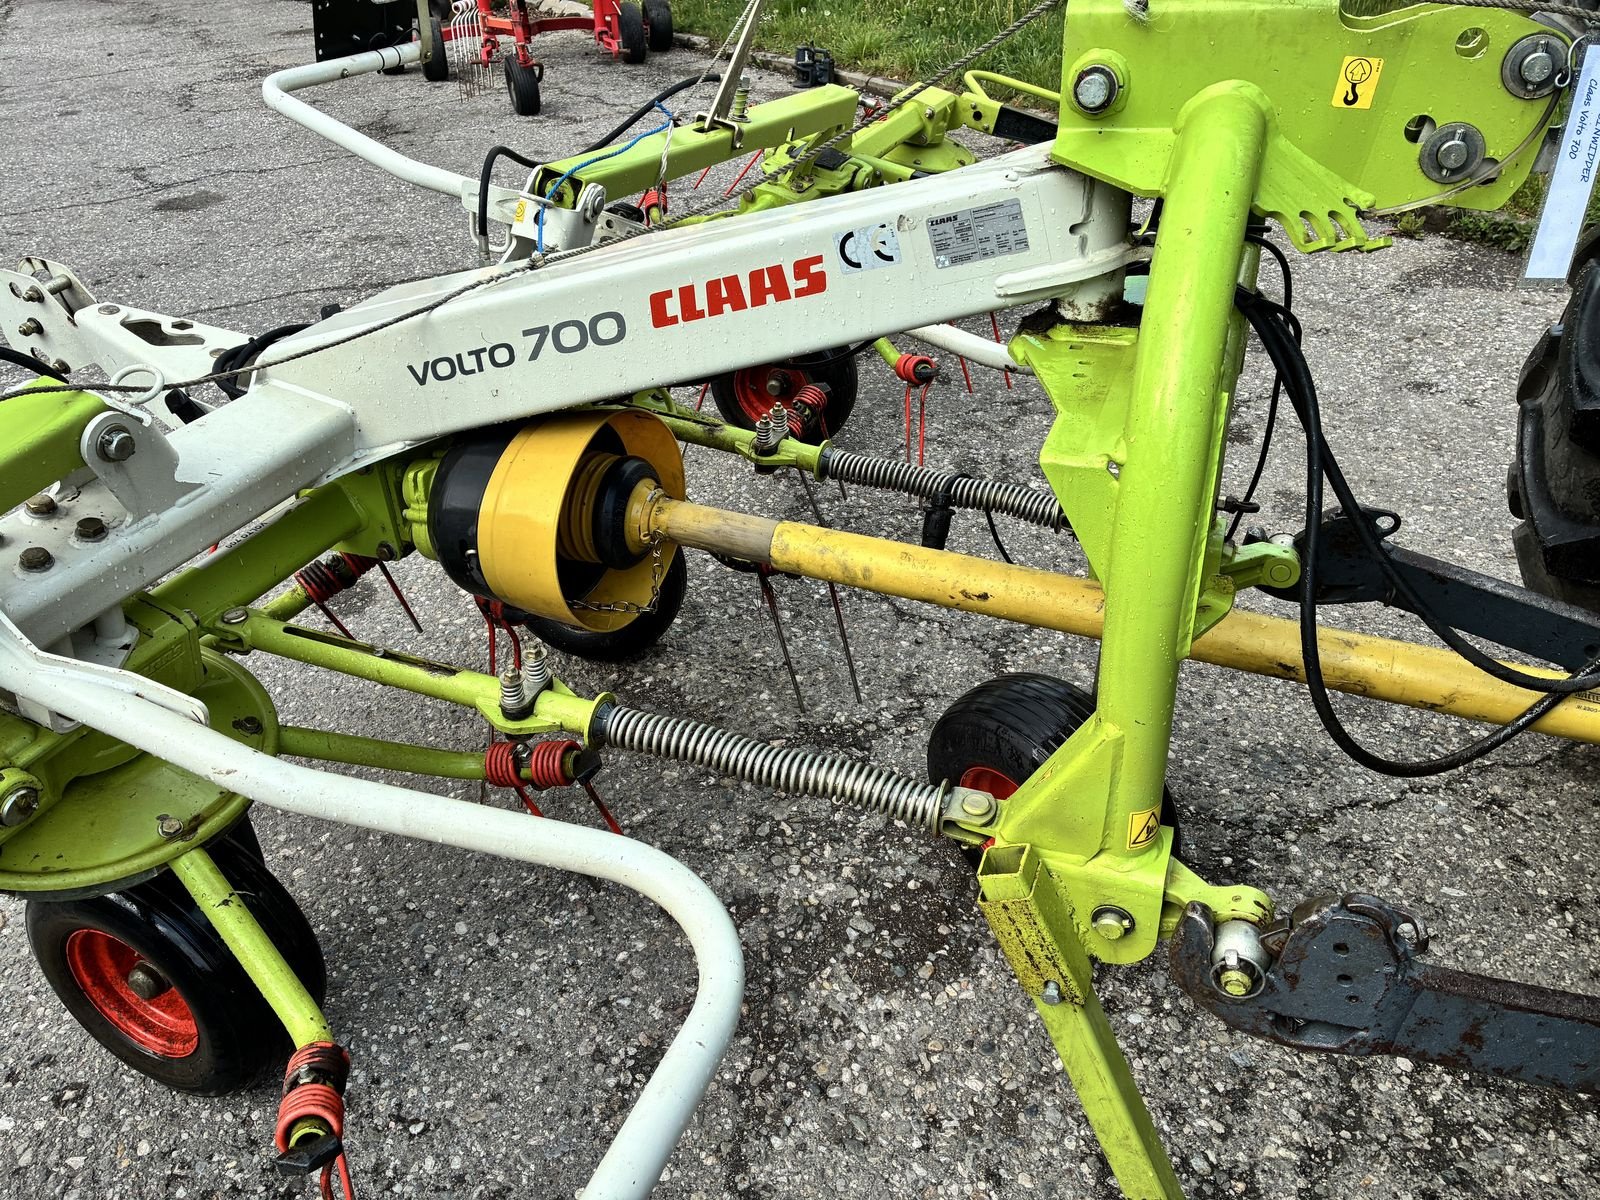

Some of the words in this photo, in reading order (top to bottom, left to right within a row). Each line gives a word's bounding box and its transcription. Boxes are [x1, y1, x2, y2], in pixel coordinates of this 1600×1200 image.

[1584, 78, 1598, 107] Claas
[1575, 110, 1589, 136] Volto
[1568, 139, 1582, 160] 700
[1580, 114, 1600, 183] INWIDDER
[930, 214, 958, 227] CLAAS
[649, 254, 827, 329] CLAAS
[406, 342, 514, 387] VOLTO
[522, 311, 627, 362] 700
[241, 522, 268, 539] VOLTO
